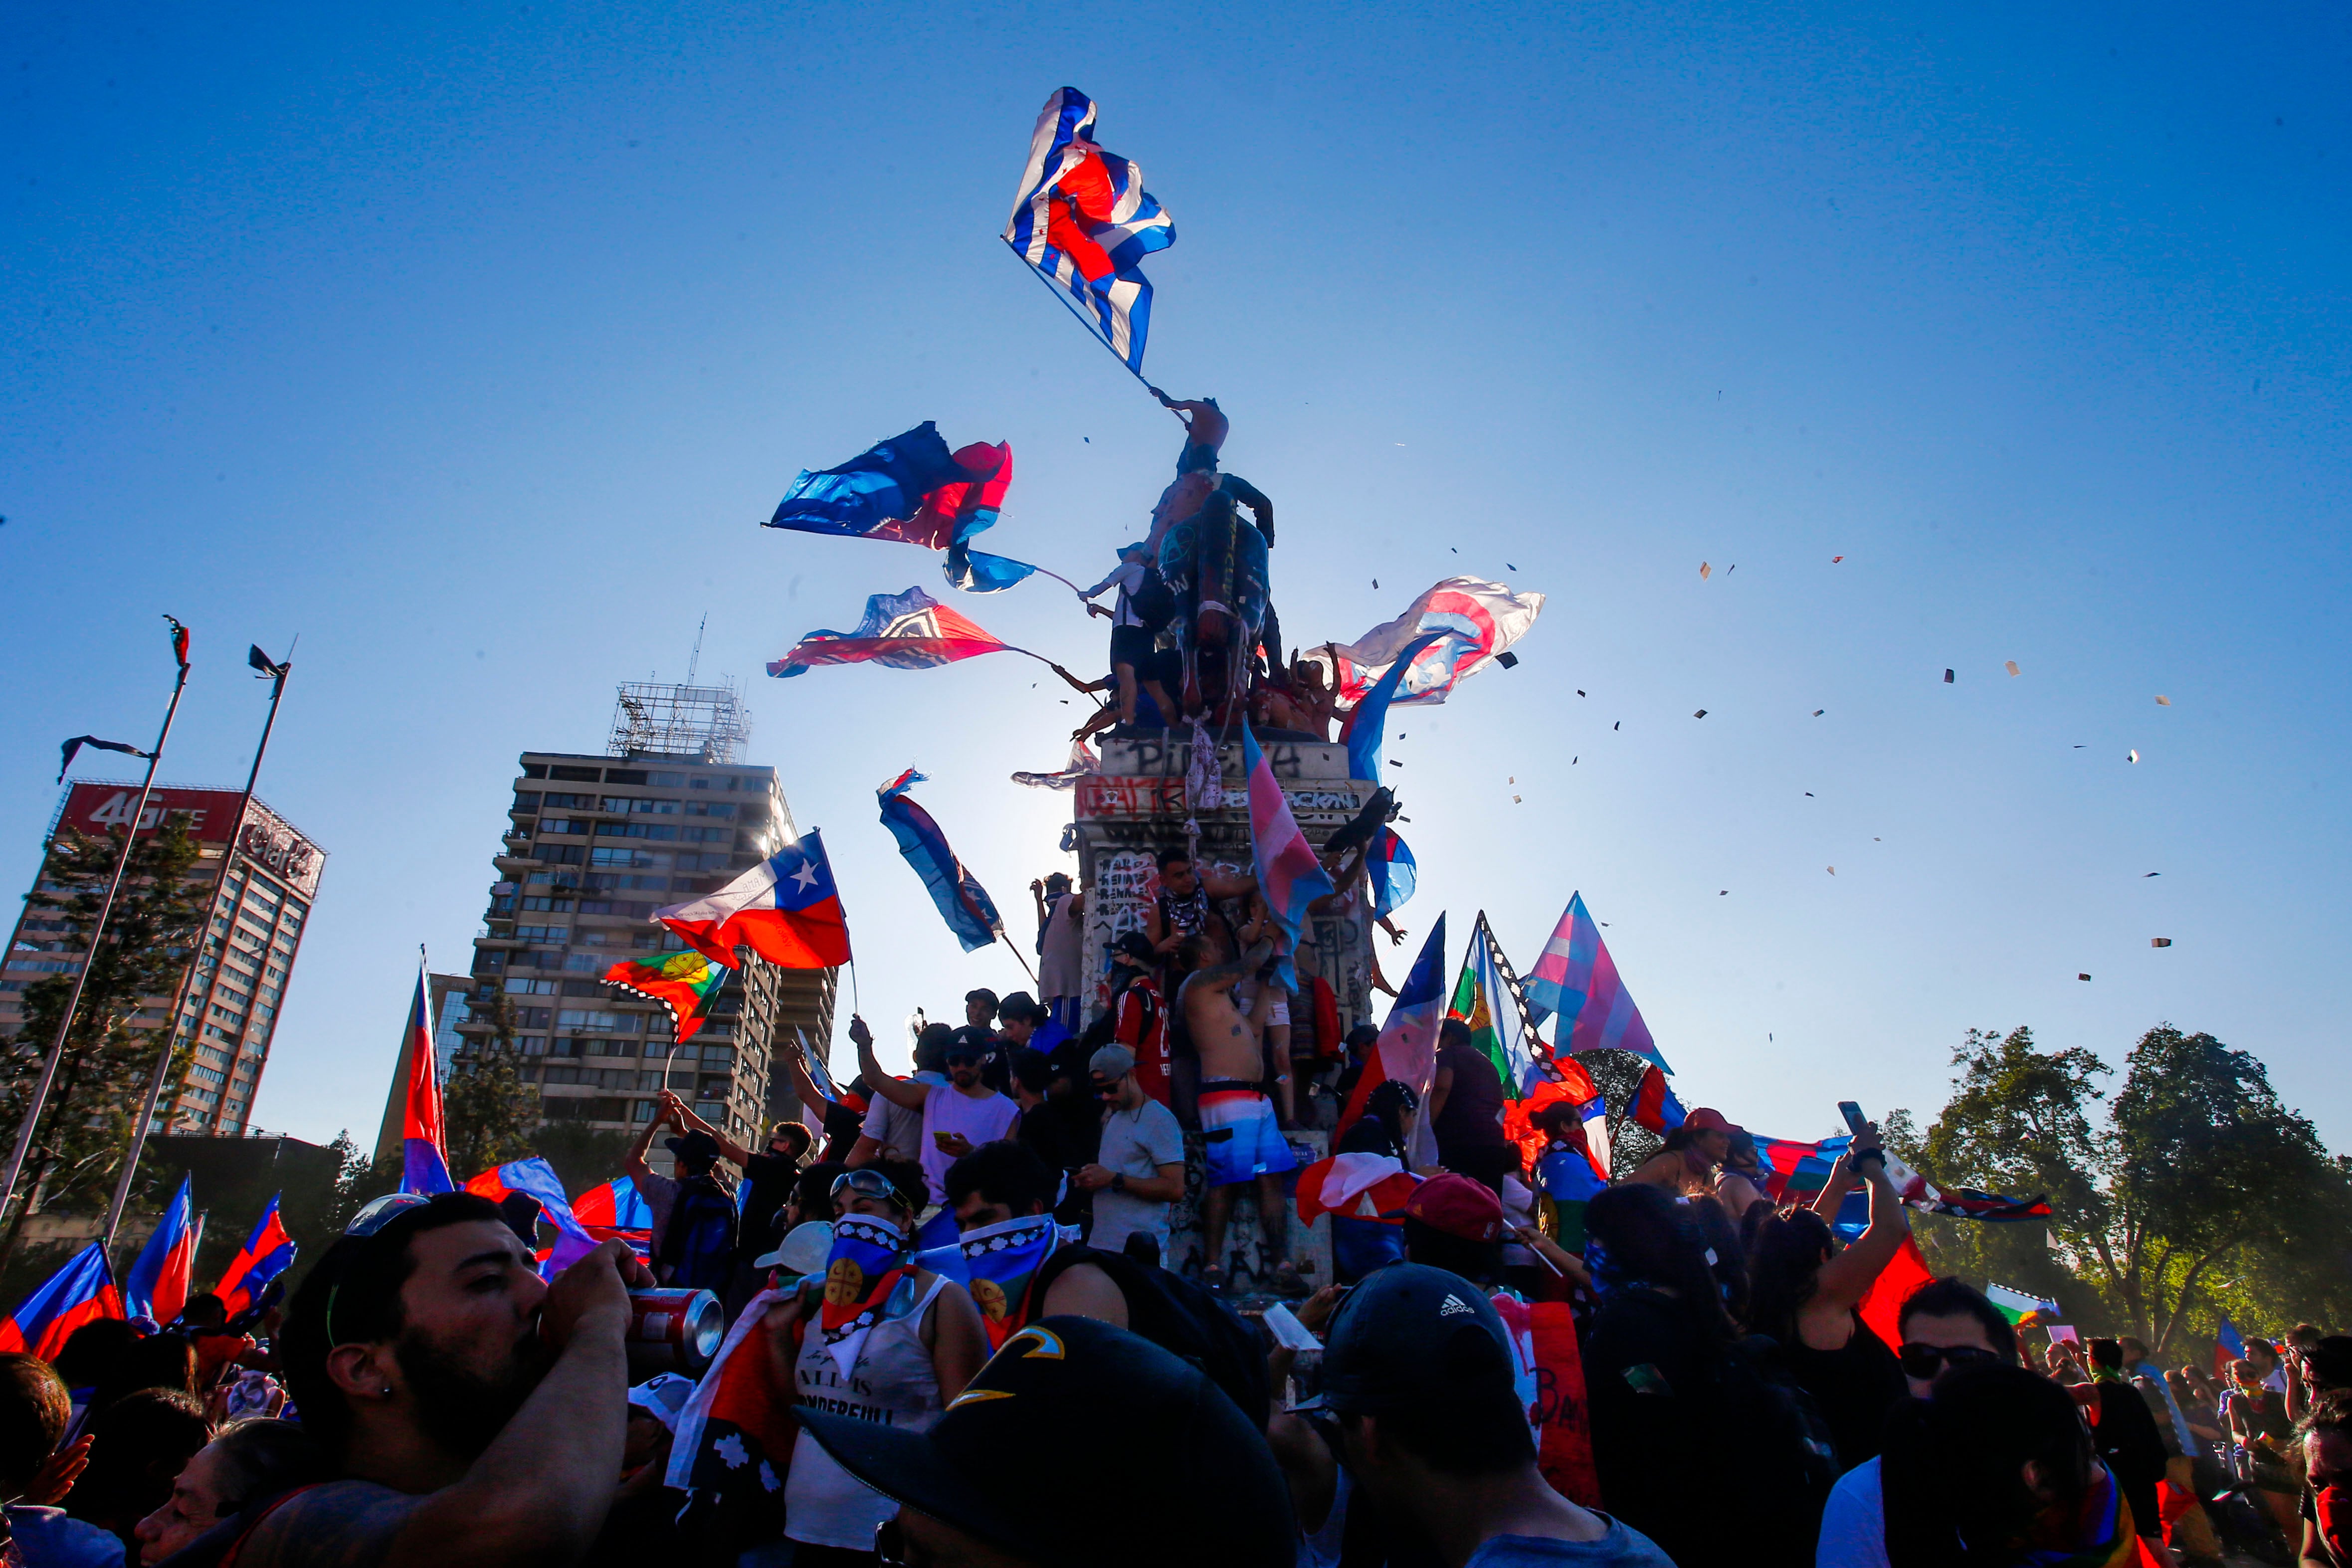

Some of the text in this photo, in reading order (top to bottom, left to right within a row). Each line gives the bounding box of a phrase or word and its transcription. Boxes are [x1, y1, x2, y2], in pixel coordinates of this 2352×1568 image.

[89, 791, 164, 831] 4G
[247, 824, 303, 878] Claro
[1440, 1305, 1475, 1317] adidas
[798, 1370, 873, 1396] ALL IS
